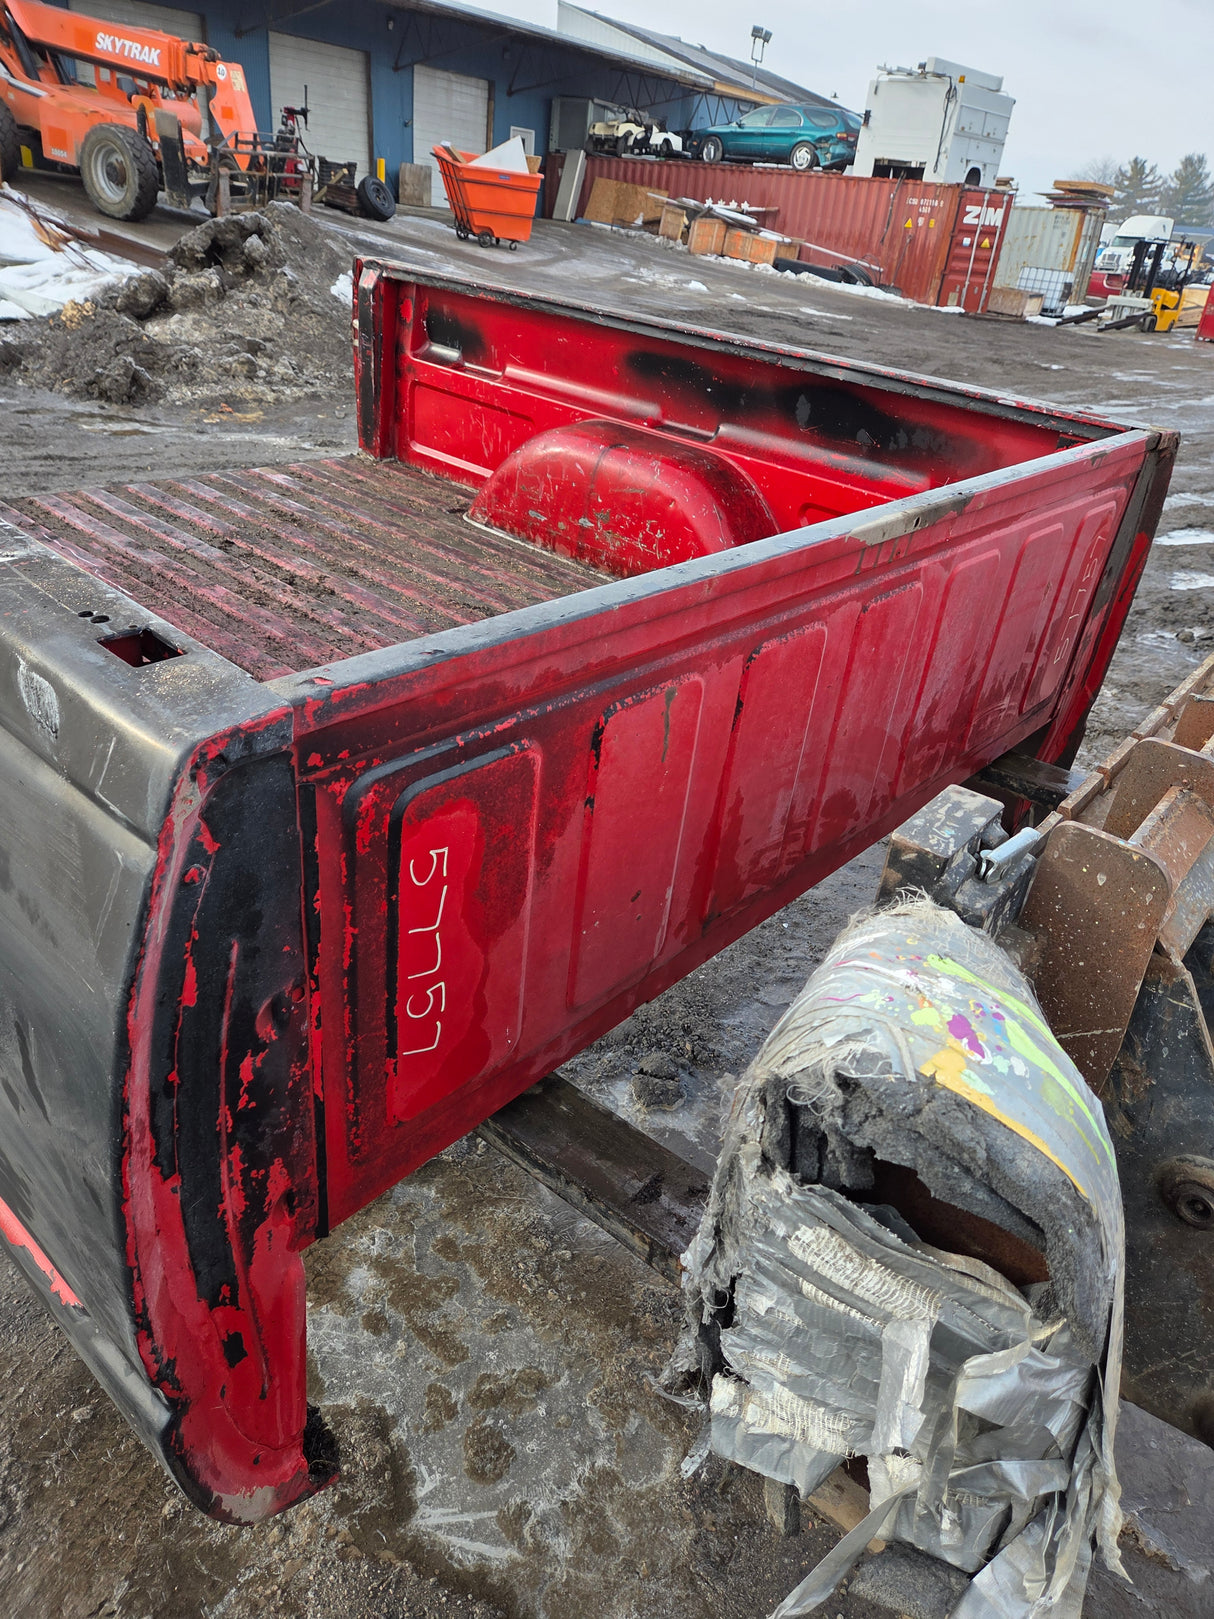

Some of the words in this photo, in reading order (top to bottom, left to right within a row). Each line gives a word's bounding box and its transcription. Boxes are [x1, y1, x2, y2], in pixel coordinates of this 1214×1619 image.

[95, 32, 161, 67] SKYTRAK
[962, 205, 1004, 227] ZIM
[1054, 535, 1106, 665] 57757
[402, 846, 449, 1056] 57757
